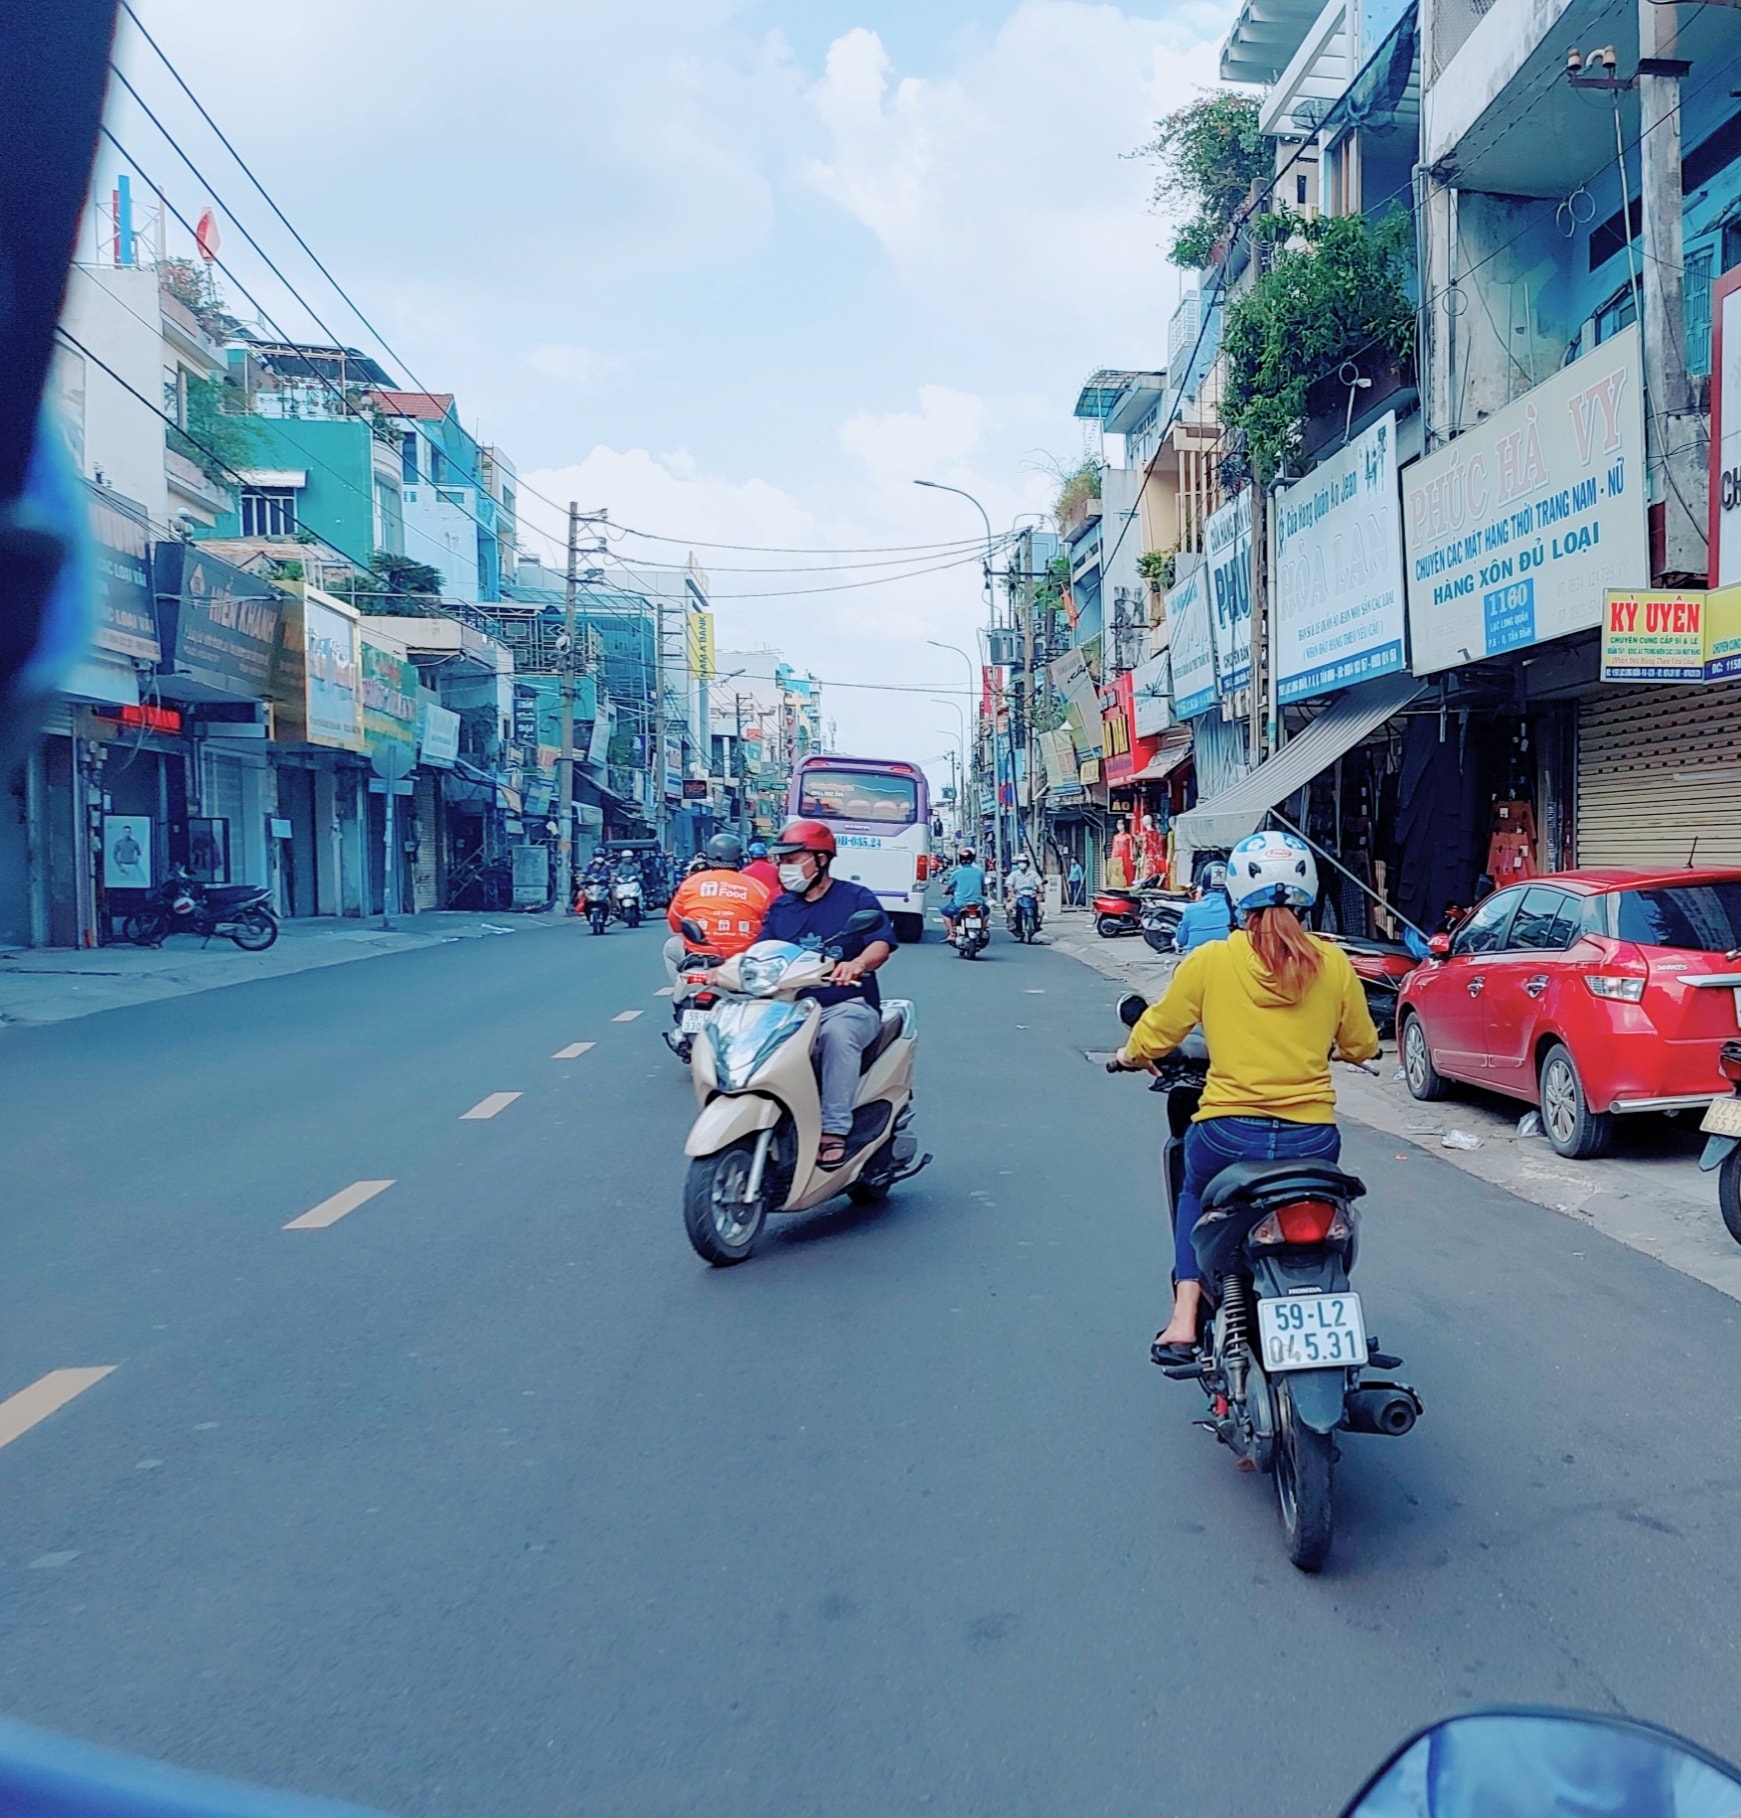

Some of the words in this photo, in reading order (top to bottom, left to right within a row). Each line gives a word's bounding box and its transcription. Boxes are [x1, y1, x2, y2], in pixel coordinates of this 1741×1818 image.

[1408, 448, 1490, 549] PHÚC
[1496, 401, 1549, 508] HÀ
[1568, 366, 1628, 466] VY
[1416, 545, 1445, 581] CHUYÊN
[1447, 536, 1463, 568] CÁC
[1464, 530, 1482, 565] MẶT
[1485, 518, 1509, 551] HÀNG
[1510, 502, 1534, 538] THỜI
[1535, 490, 1570, 523] TRANG
[1572, 477, 1597, 513] NAM
[1607, 456, 1625, 498] NỮ
[1433, 574, 1474, 606] HÀNG
[1479, 557, 1513, 588] XÔN
[1519, 537, 1544, 573] ĐỦ
[1552, 521, 1599, 560] LOẠI
[1488, 583, 1528, 617] 1160
[1610, 594, 1638, 632] KỲ
[1646, 595, 1700, 633] UYÊN
[720, 888, 747, 900] Food
[1275, 1300, 1346, 1331] 59-L2
[1269, 1330, 1356, 1364] 045.31
